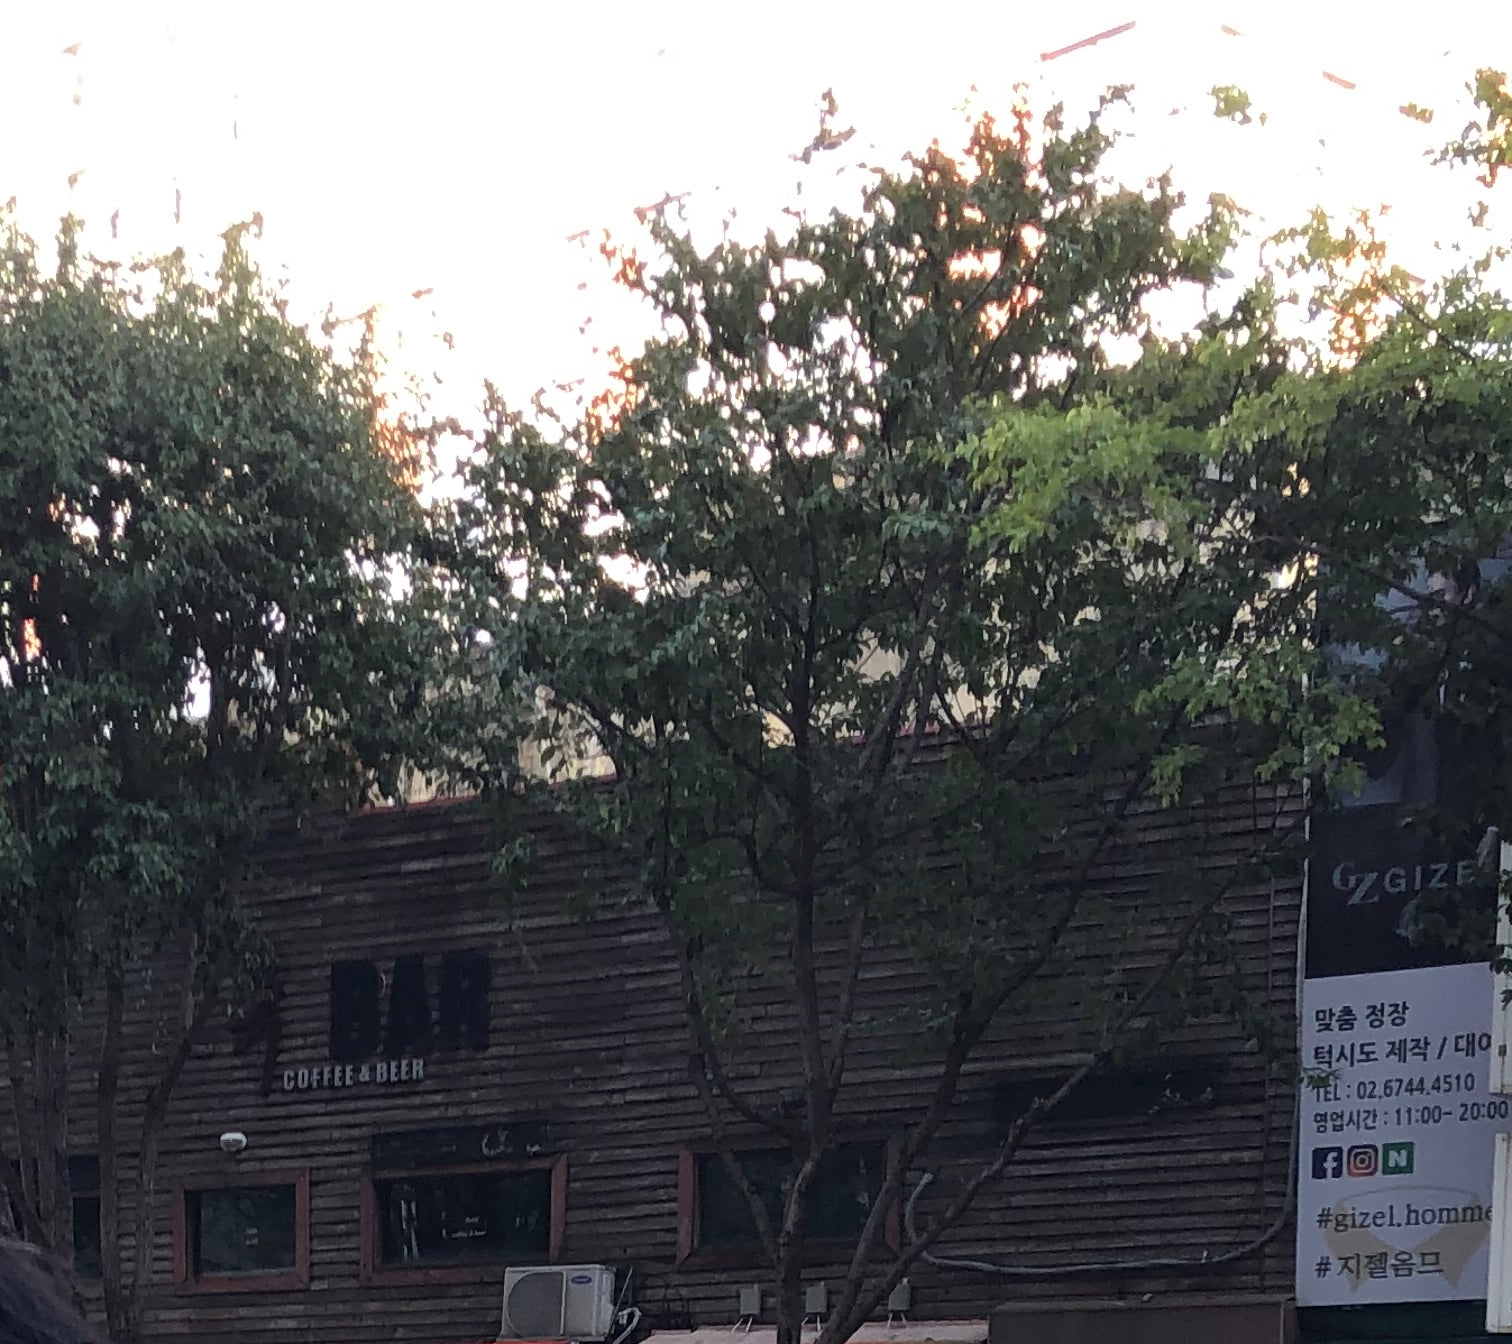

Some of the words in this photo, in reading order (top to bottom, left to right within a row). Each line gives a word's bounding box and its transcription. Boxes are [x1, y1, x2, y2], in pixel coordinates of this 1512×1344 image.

[1384, 859, 1475, 893] GIZE
[1315, 1006, 1357, 1033] 맞춤
[1365, 1001, 1409, 1029] 정장
[1313, 1042, 1379, 1068] 턱시도
[1385, 1036, 1431, 1063] 제작
[283, 1064, 354, 1090] COFFEE
[359, 1066, 371, 1083] &
[376, 1059, 425, 1083] BEER
[1356, 1072, 1475, 1100] 02.6744.4510
[1314, 1109, 1377, 1133] 영업시간
[1459, 1101, 1509, 1121] 20:00
